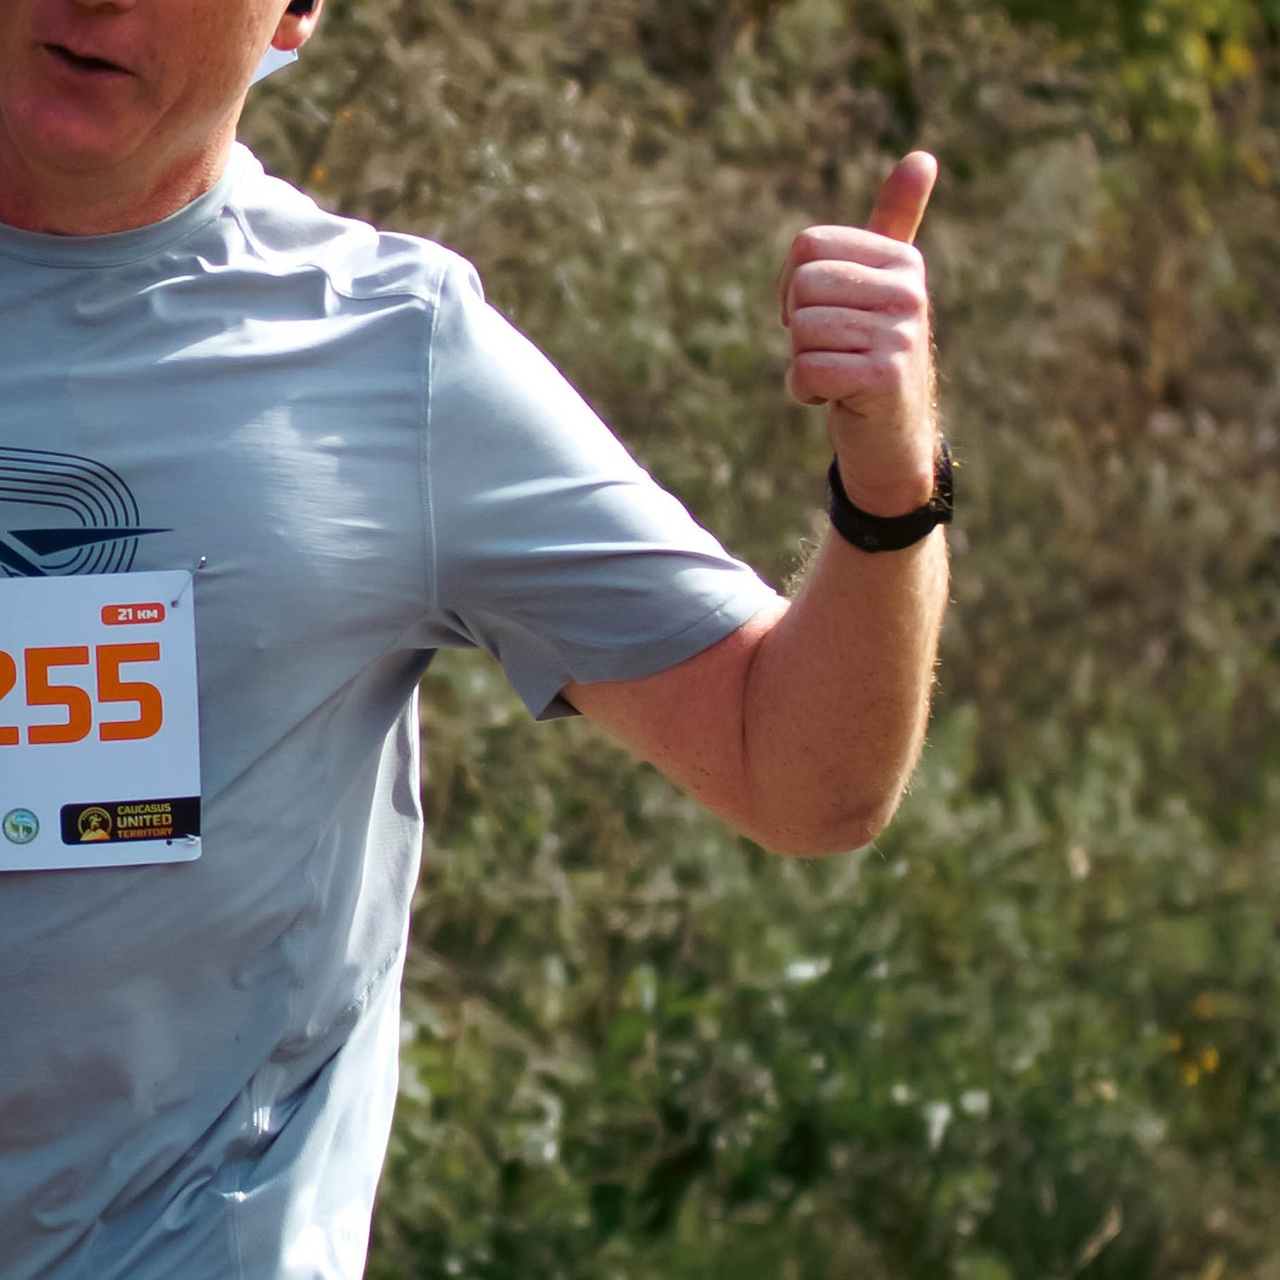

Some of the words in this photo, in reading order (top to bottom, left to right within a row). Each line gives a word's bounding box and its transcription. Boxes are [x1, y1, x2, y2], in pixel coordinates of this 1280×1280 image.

[117, 608, 133, 621] 21
[117, 803, 171, 815] CAUCASUS
[116, 813, 172, 828] UNITED
[117, 827, 173, 839] TERRITORY
